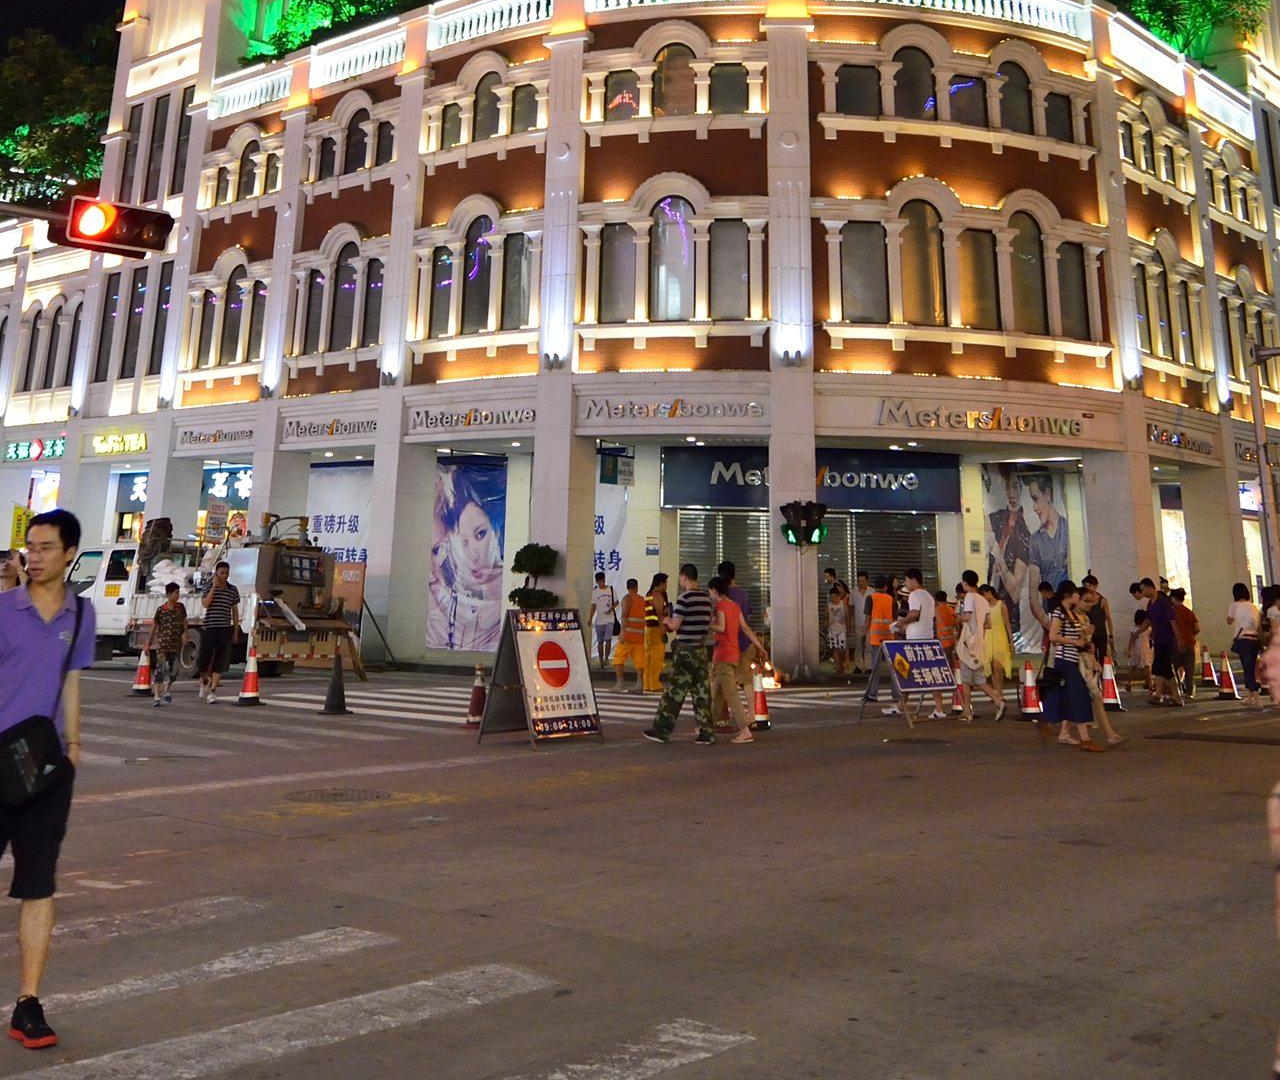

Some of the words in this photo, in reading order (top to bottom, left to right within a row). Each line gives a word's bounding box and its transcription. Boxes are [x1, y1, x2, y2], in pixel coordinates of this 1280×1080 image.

[412, 407, 536, 430] Meters/bonwe
[583, 397, 765, 421] Meters/bonwe
[877, 399, 1085, 437] Meters/bonwe
[312, 514, 360, 534] 重磅升级
[903, 645, 945, 662] 前方施工
[912, 667, 953, 685] 车辆慢行
